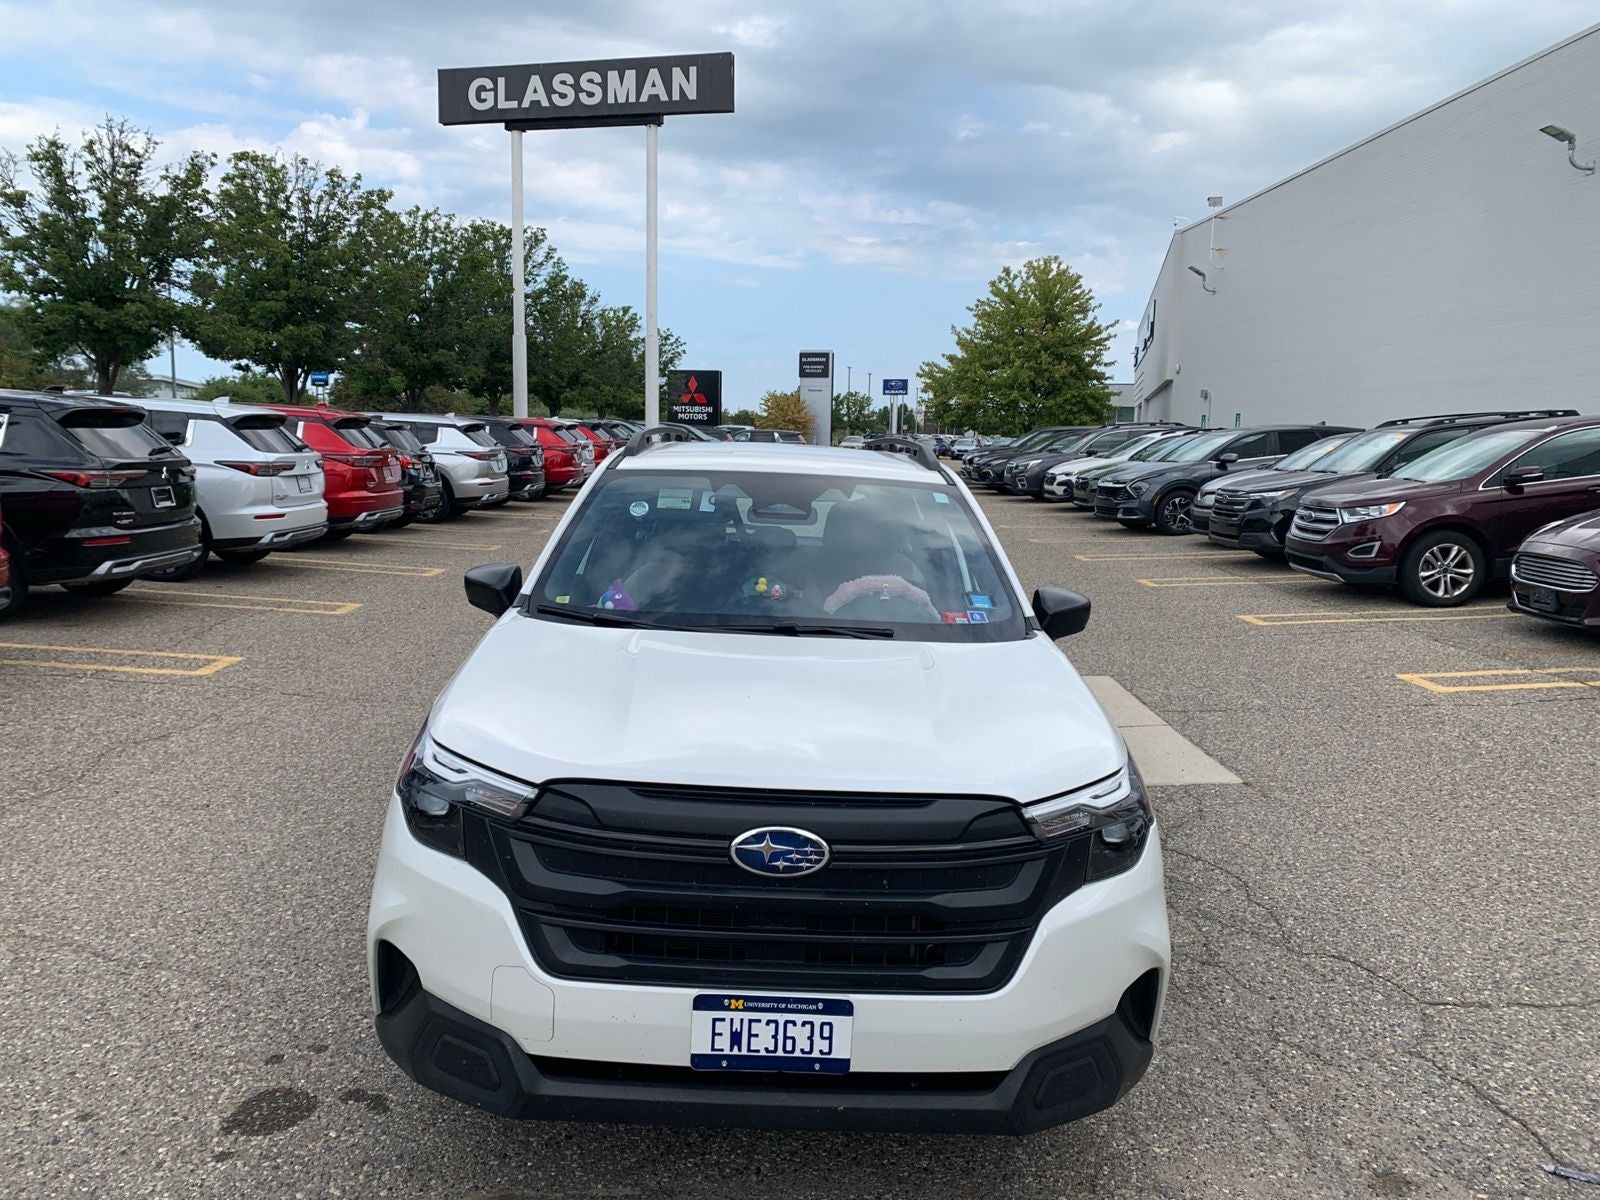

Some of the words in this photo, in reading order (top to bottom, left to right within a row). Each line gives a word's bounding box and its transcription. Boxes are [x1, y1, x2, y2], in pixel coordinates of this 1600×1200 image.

[468, 65, 698, 111] GLASSMAN
[673, 405, 713, 413] MITSUBISHI
[730, 998, 744, 1009] M
[744, 1001, 778, 1009] UNIVERSITY
[710, 1017, 834, 1056] EWE3639
